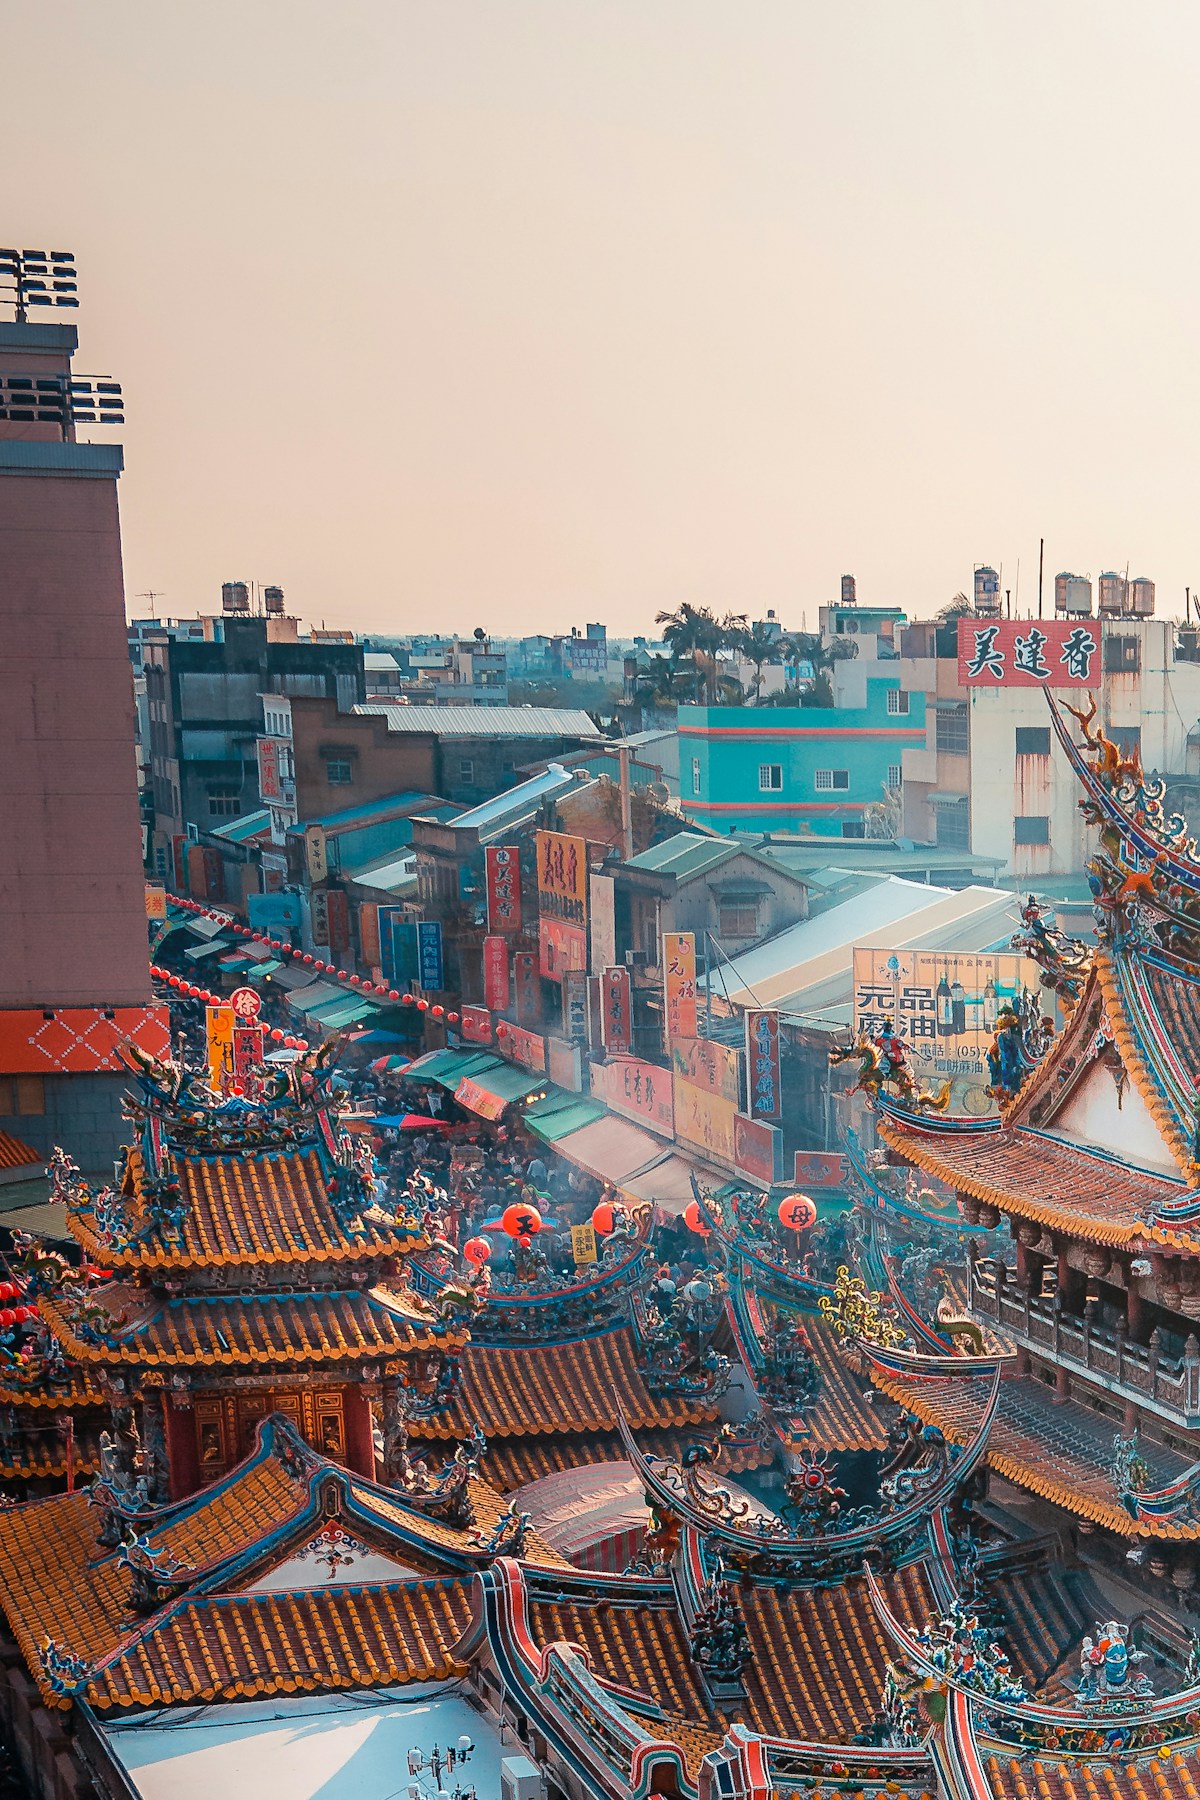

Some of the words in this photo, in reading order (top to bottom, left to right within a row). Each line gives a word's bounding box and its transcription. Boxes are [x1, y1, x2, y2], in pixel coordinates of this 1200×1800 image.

[963, 625, 1098, 680] 美達香
[235, 992, 258, 1015] 徐
[857, 985, 936, 1012] 元品
[517, 1216, 537, 1235] 天
[789, 1205, 812, 1224] 母
